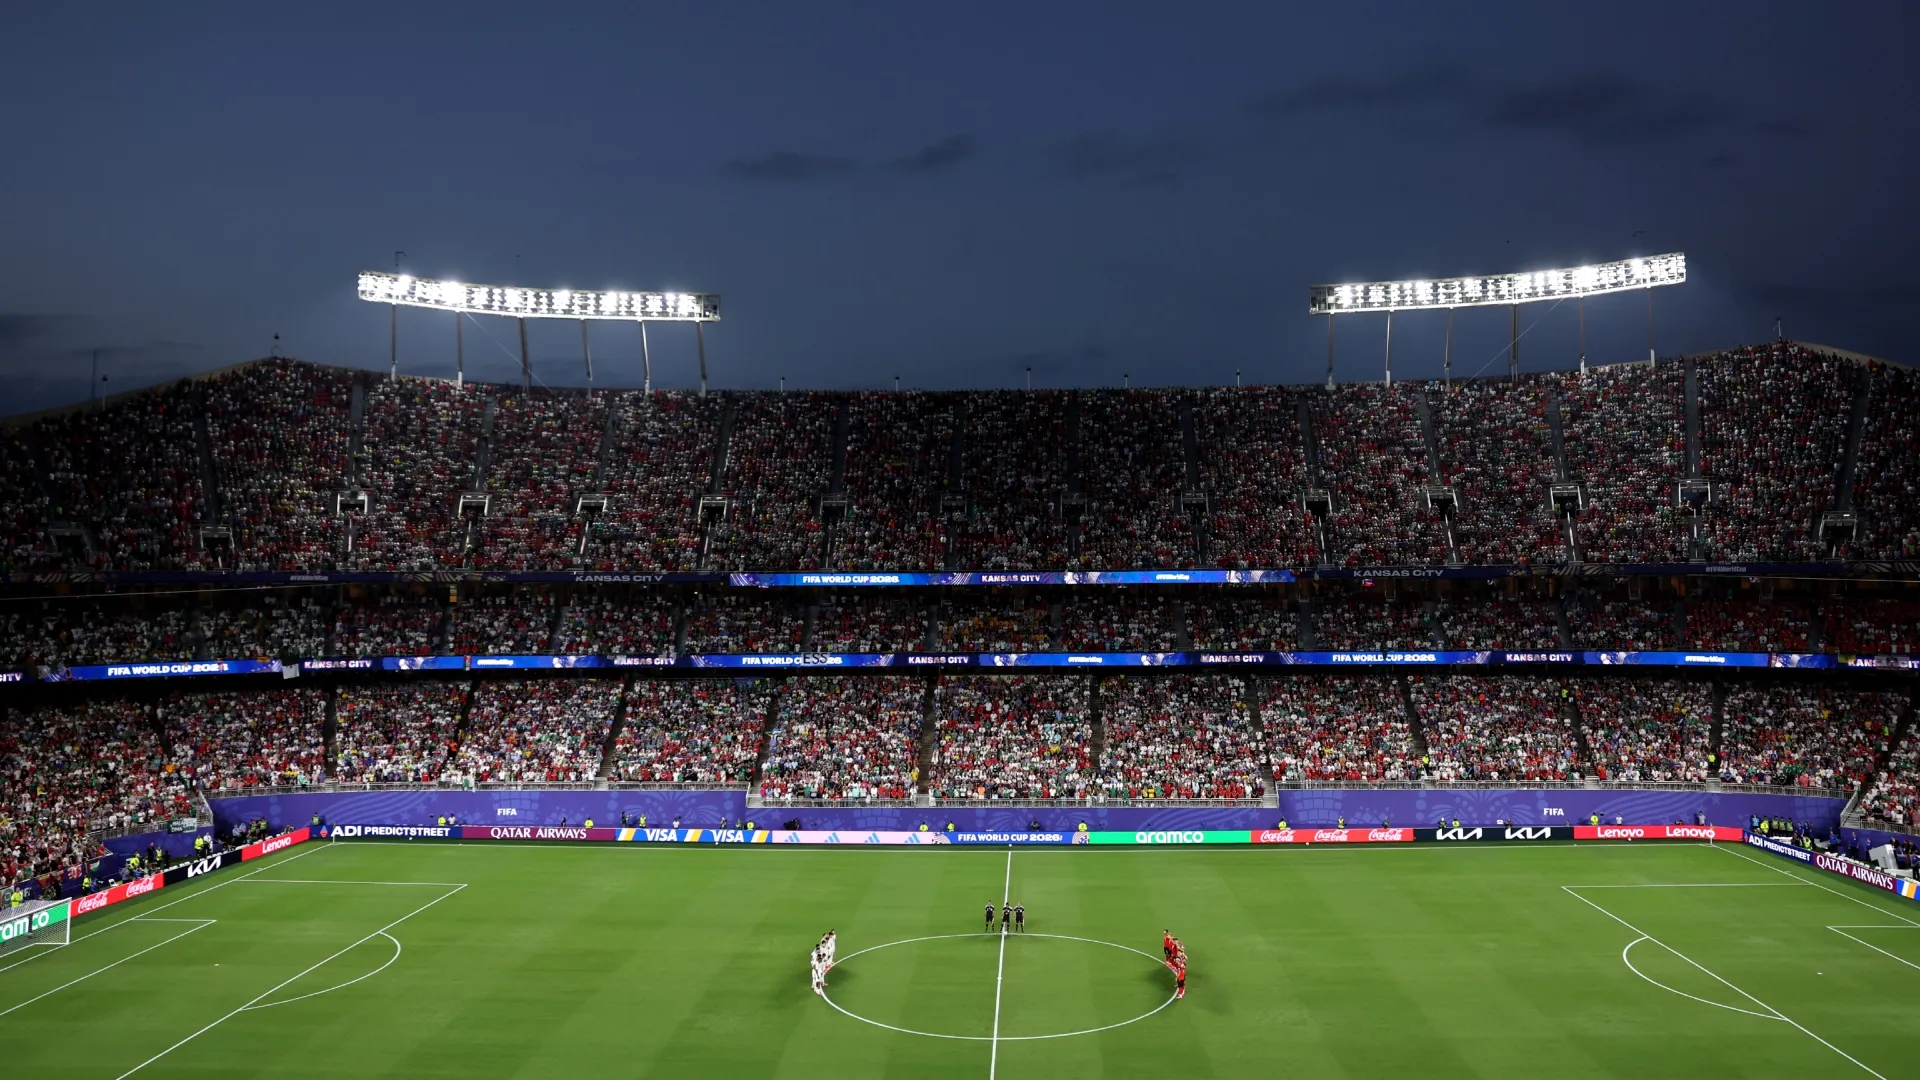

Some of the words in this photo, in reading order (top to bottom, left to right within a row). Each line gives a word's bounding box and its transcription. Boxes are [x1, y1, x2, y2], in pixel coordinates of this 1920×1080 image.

[1020, 574, 1040, 582] CITY
[1353, 569, 1410, 577] KANSAS
[1412, 569, 1443, 577] CITY
[304, 659, 346, 669] KANSAS
[348, 659, 372, 668] CITY
[653, 657, 675, 665] CITY
[742, 657, 761, 665] FIFA
[761, 657, 793, 665] WORLD
[908, 656, 946, 664] KANSAS
[947, 656, 969, 664] CITY
[1200, 655, 1240, 663] KANSAS
[1332, 654, 1351, 662] FIFA
[1352, 654, 1384, 662] WORLD
[1386, 654, 1403, 662] CUP
[1404, 654, 1436, 662] 2026
[1506, 654, 1547, 662] KANSAS
[1548, 654, 1572, 662] CITY
[107, 667, 131, 676] FIFA
[132, 665, 170, 674] WORLD
[171, 663, 192, 673] CUP
[497, 808, 517, 816] FIFA
[1543, 808, 1564, 816] FIFA
[331, 825, 362, 837] ADI
[364, 826, 450, 837] PREDICTSTREET
[490, 827, 531, 839] QATAR
[536, 828, 587, 839] AIRWAYS
[643, 829, 678, 842] VISA
[711, 829, 744, 843] VISA
[1436, 827, 1483, 840] KIA
[1505, 827, 1552, 840] KIA
[1597, 826, 1645, 838] Lenovo
[1666, 825, 1716, 839] Lenovo
[957, 834, 977, 842] FIFA
[977, 834, 1010, 842] WORLD
[1010, 834, 1028, 842] CUP
[1029, 834, 1060, 842] 2026
[1135, 831, 1204, 844] aramco
[262, 837, 292, 854] Lenovo
[1748, 834, 1763, 848] ADI
[1764, 841, 1811, 862] PREDICTSTREET
[187, 855, 222, 878] KIA
[1816, 854, 1849, 875] QATAR
[1851, 865, 1894, 890] AIRWAYS
[0, 911, 50, 941] amco
